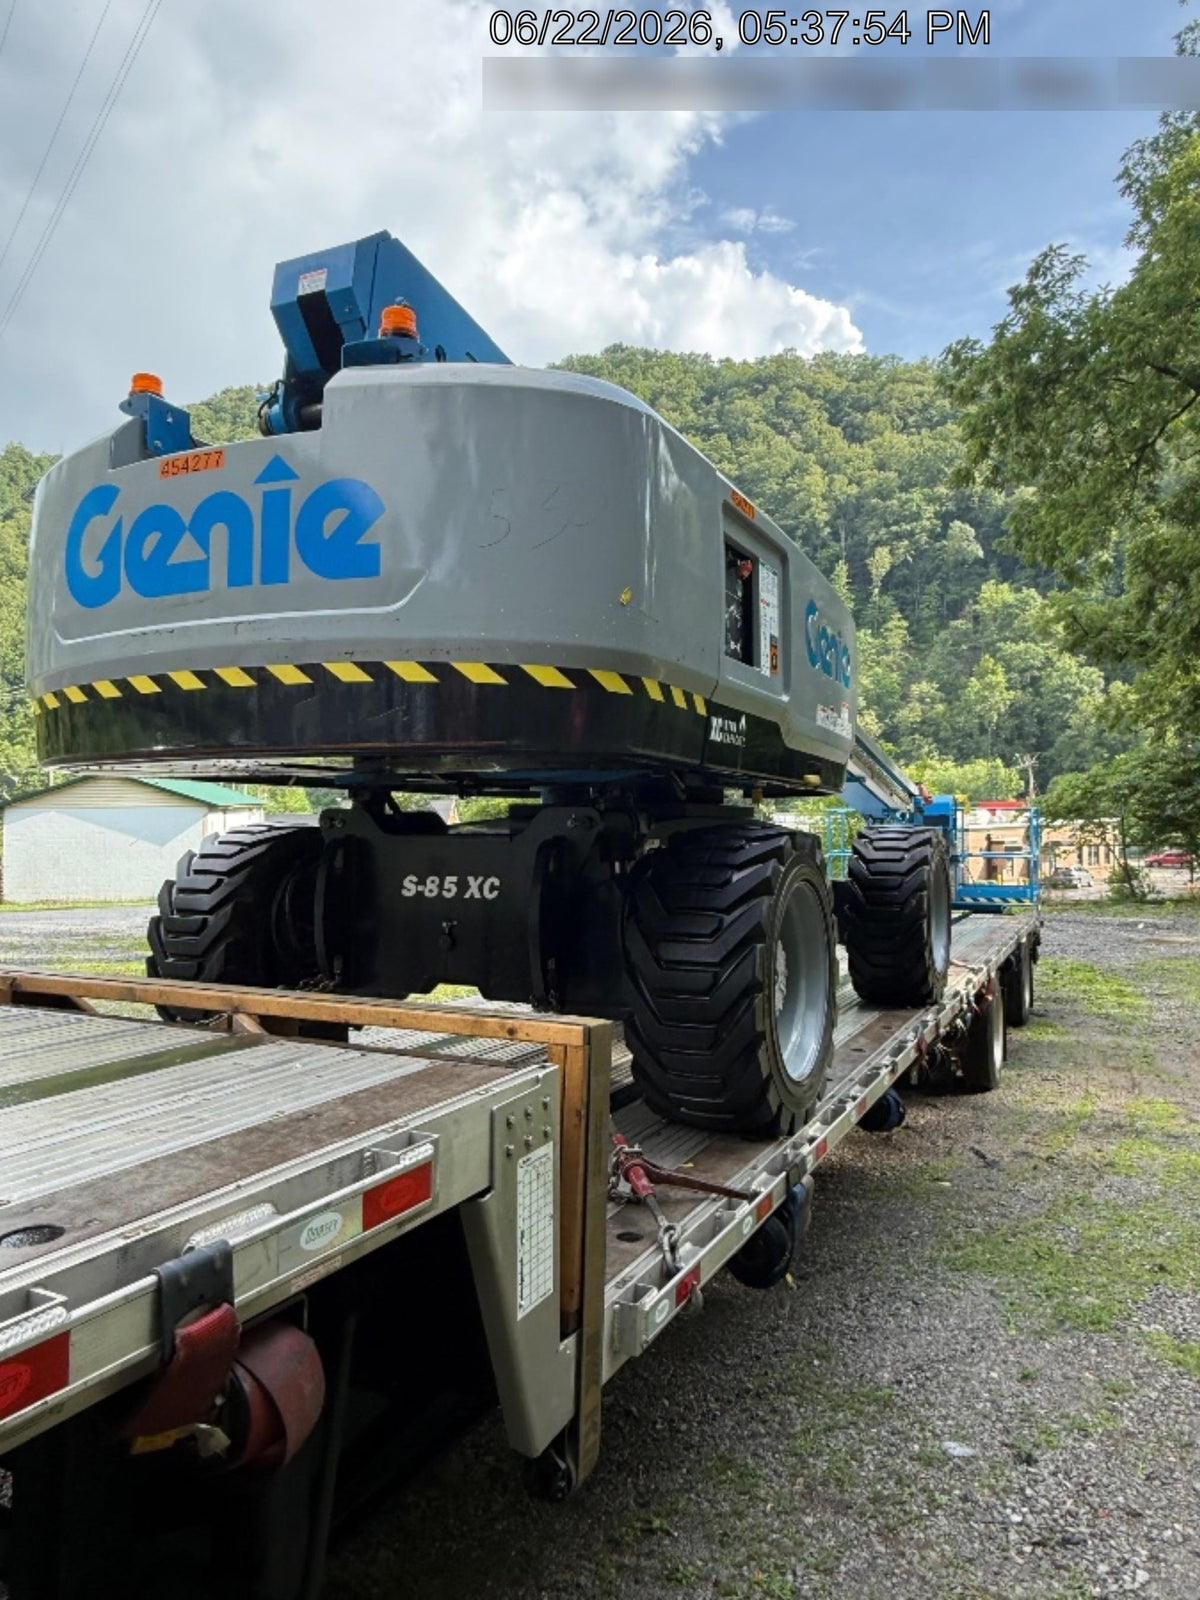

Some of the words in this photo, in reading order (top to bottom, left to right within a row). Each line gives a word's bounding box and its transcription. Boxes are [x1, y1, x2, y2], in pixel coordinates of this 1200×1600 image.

[161, 449, 223, 476] 454277
[65, 454, 386, 609] Genie
[401, 875, 459, 899] S-85
[463, 875, 500, 900] XC
